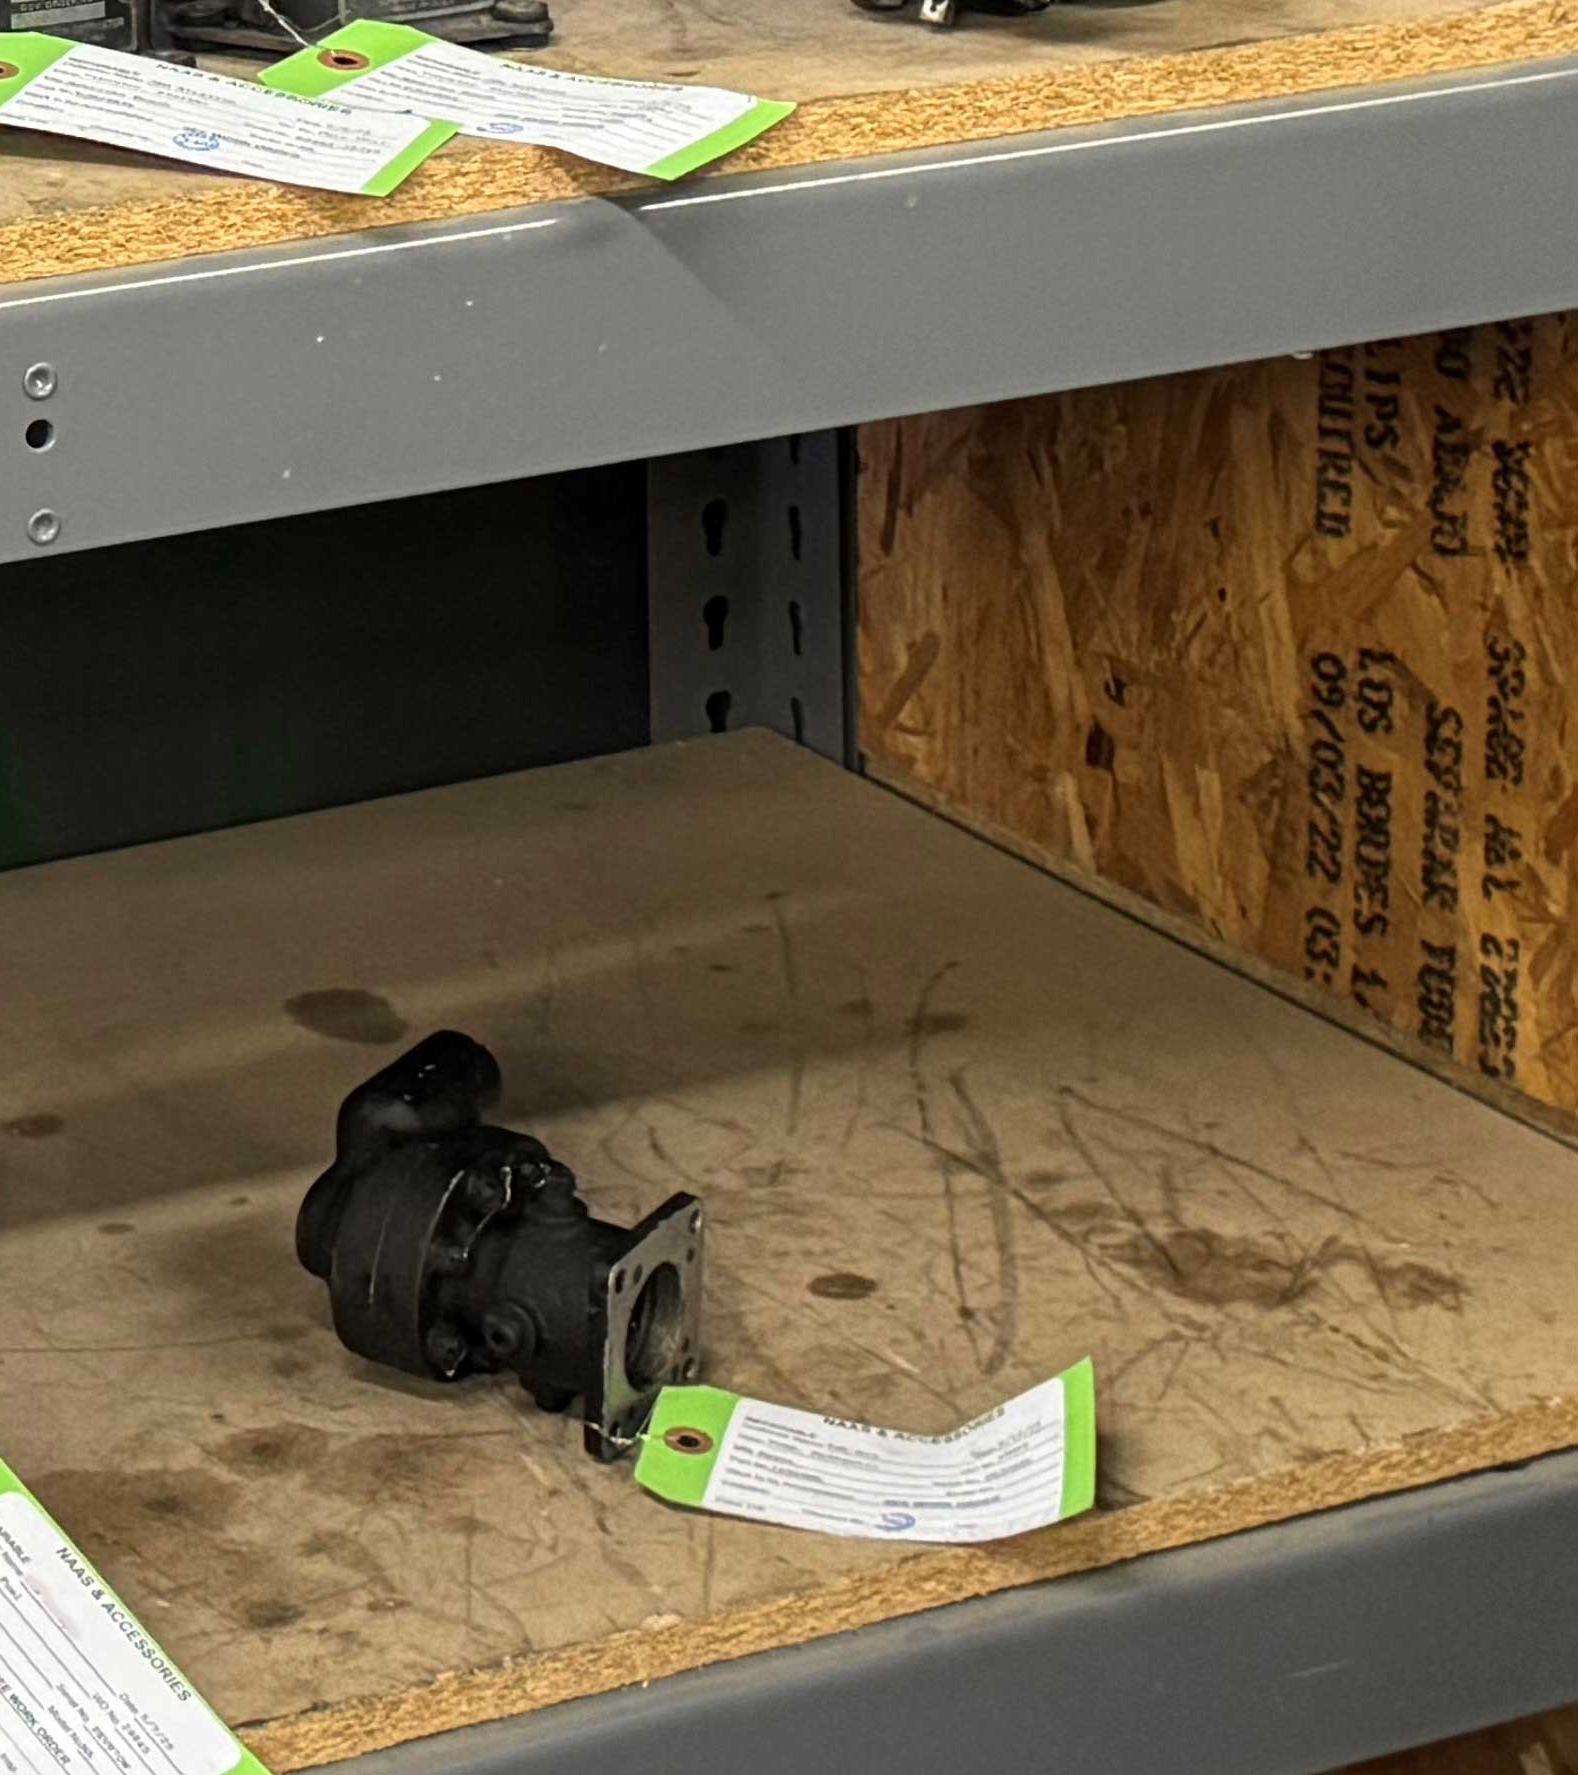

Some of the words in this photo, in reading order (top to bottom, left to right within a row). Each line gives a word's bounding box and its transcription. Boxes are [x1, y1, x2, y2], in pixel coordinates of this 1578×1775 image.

[1357, 649, 1396, 733] LOS
[1308, 653, 1345, 882] 09/03/22
[56, 1547, 94, 1587] NAAS
[91, 1589, 105, 1600] &
[102, 1594, 191, 1701] ACCESSORIES
[9, 1693, 37, 1729] WORK
[37, 1727, 71, 1767] ORDER
